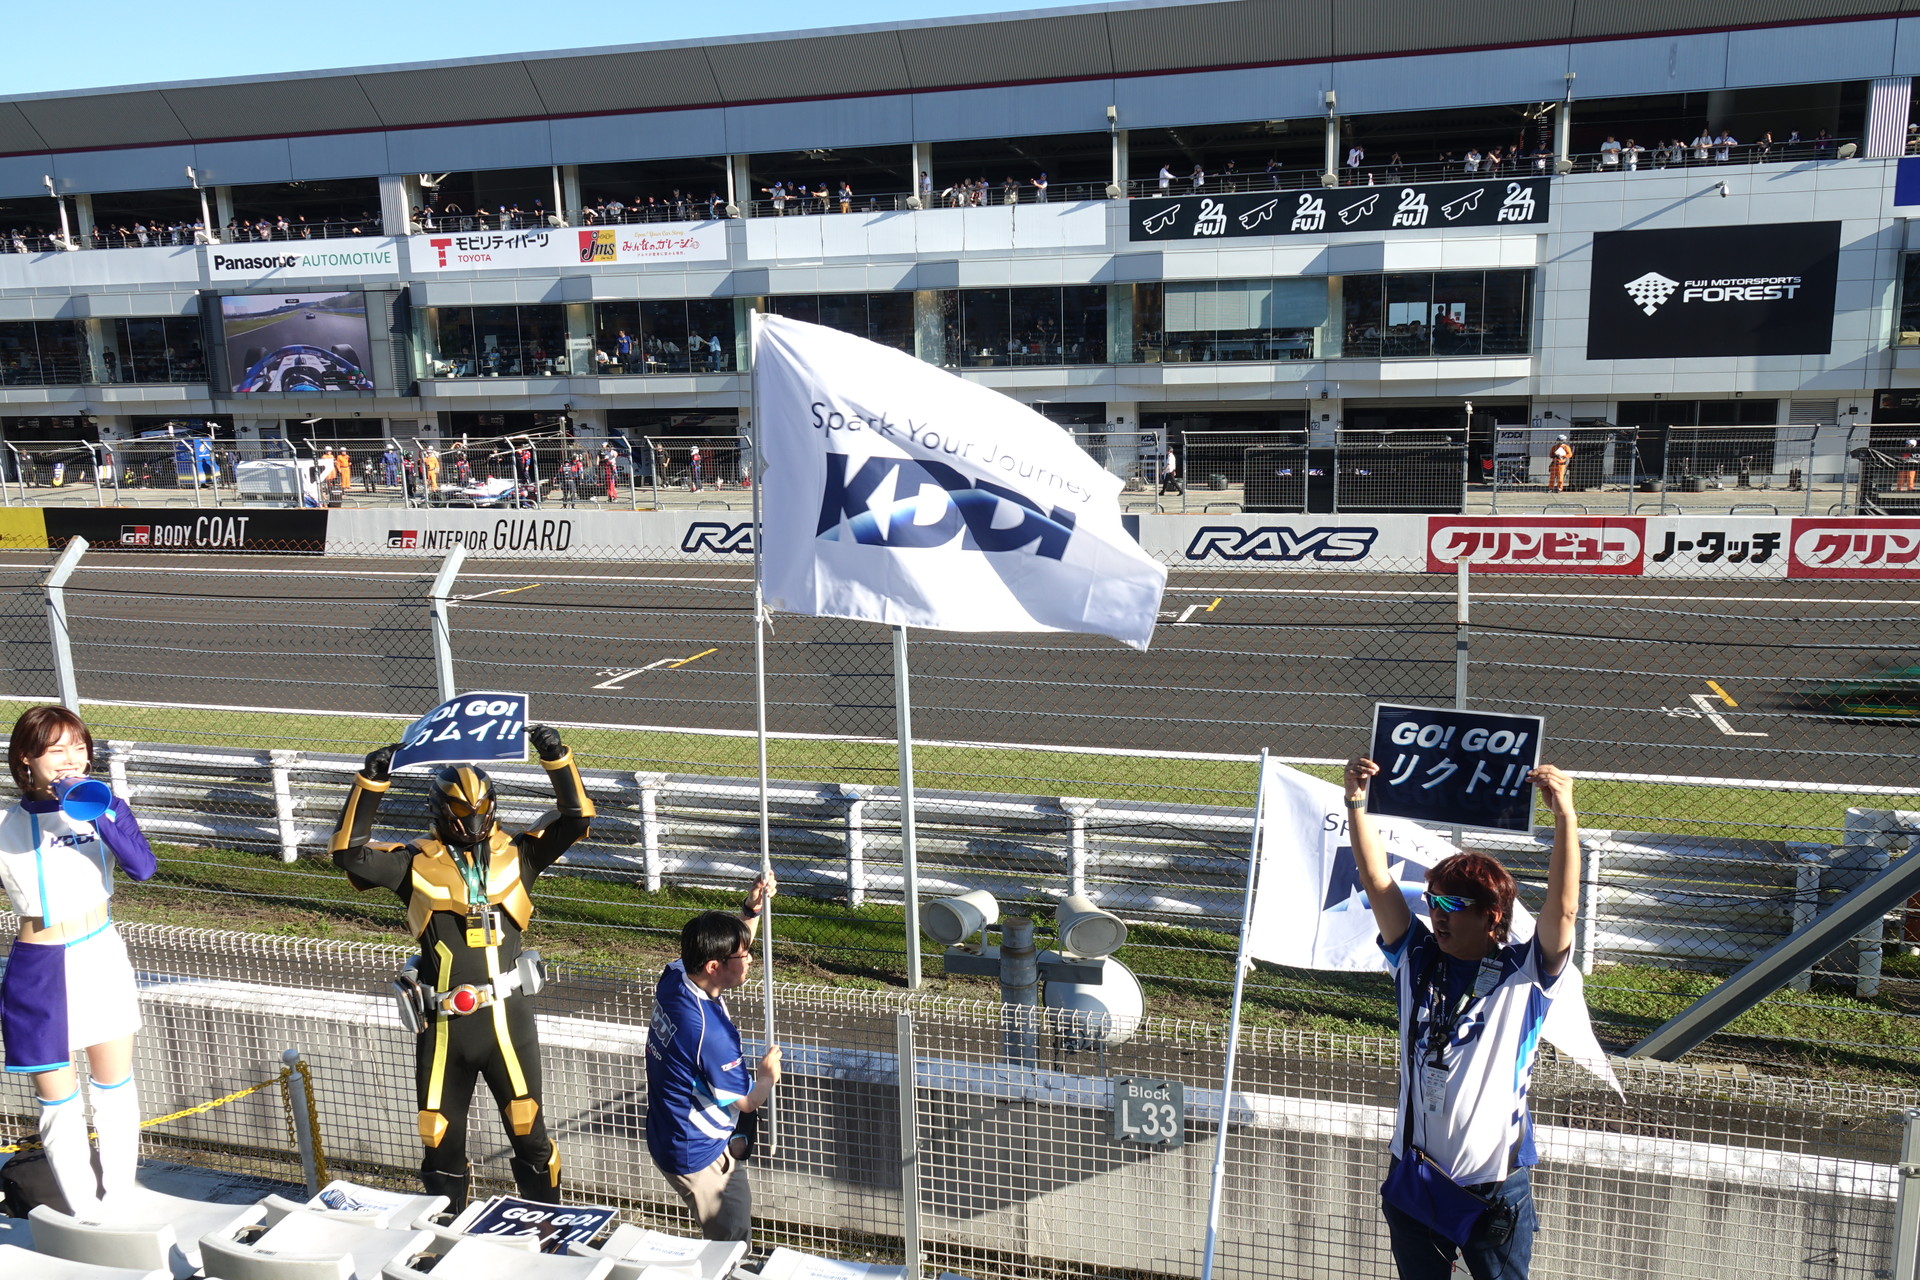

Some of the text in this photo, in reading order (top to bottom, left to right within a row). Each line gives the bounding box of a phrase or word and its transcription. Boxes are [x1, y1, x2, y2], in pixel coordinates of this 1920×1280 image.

[1297, 193, 1323, 214] 24
[1398, 188, 1426, 210] 24
[1504, 182, 1532, 204] 24
[1198, 199, 1224, 219] 24
[1392, 208, 1429, 226] FUJI
[1497, 203, 1535, 221] FUJI
[1193, 217, 1227, 235] FUJI
[1291, 213, 1326, 231] FUJI
[456, 233, 549, 250] モビリティパーツ
[581, 231, 615, 261] jms
[622, 237, 694, 251] みんなのガレージ
[302, 251, 392, 267] AUTOMOTIVE
[458, 254, 491, 262] TOYOTA
[1711, 276, 1802, 286] MOTORSPORTS
[1683, 285, 1801, 303] FOREST
[1501, 431, 1523, 439] KDDI
[811, 401, 1094, 503] Spark Your Journey
[816, 452, 1076, 561] KDDI
[123, 516, 249, 547] GR BODY COAT
[388, 519, 571, 551] GR INTERIOR GUARD
[681, 522, 762, 554] RA
[1186, 526, 1378, 562] RAYS
[1445, 531, 1624, 563] クリンビュー
[1652, 531, 1781, 563] ノータッチ
[1811, 534, 1920, 564] クリン
[464, 700, 518, 717] GO!
[1391, 721, 1529, 756] GO! GO!
[1389, 753, 1531, 797] リクト!!
[1323, 812, 1400, 845] Sprk
[50, 831, 95, 851] KDDI
[1128, 1085, 1171, 1101] Block
[1122, 1099, 1178, 1138] L33
[502, 1207, 603, 1227] GO! GO!
